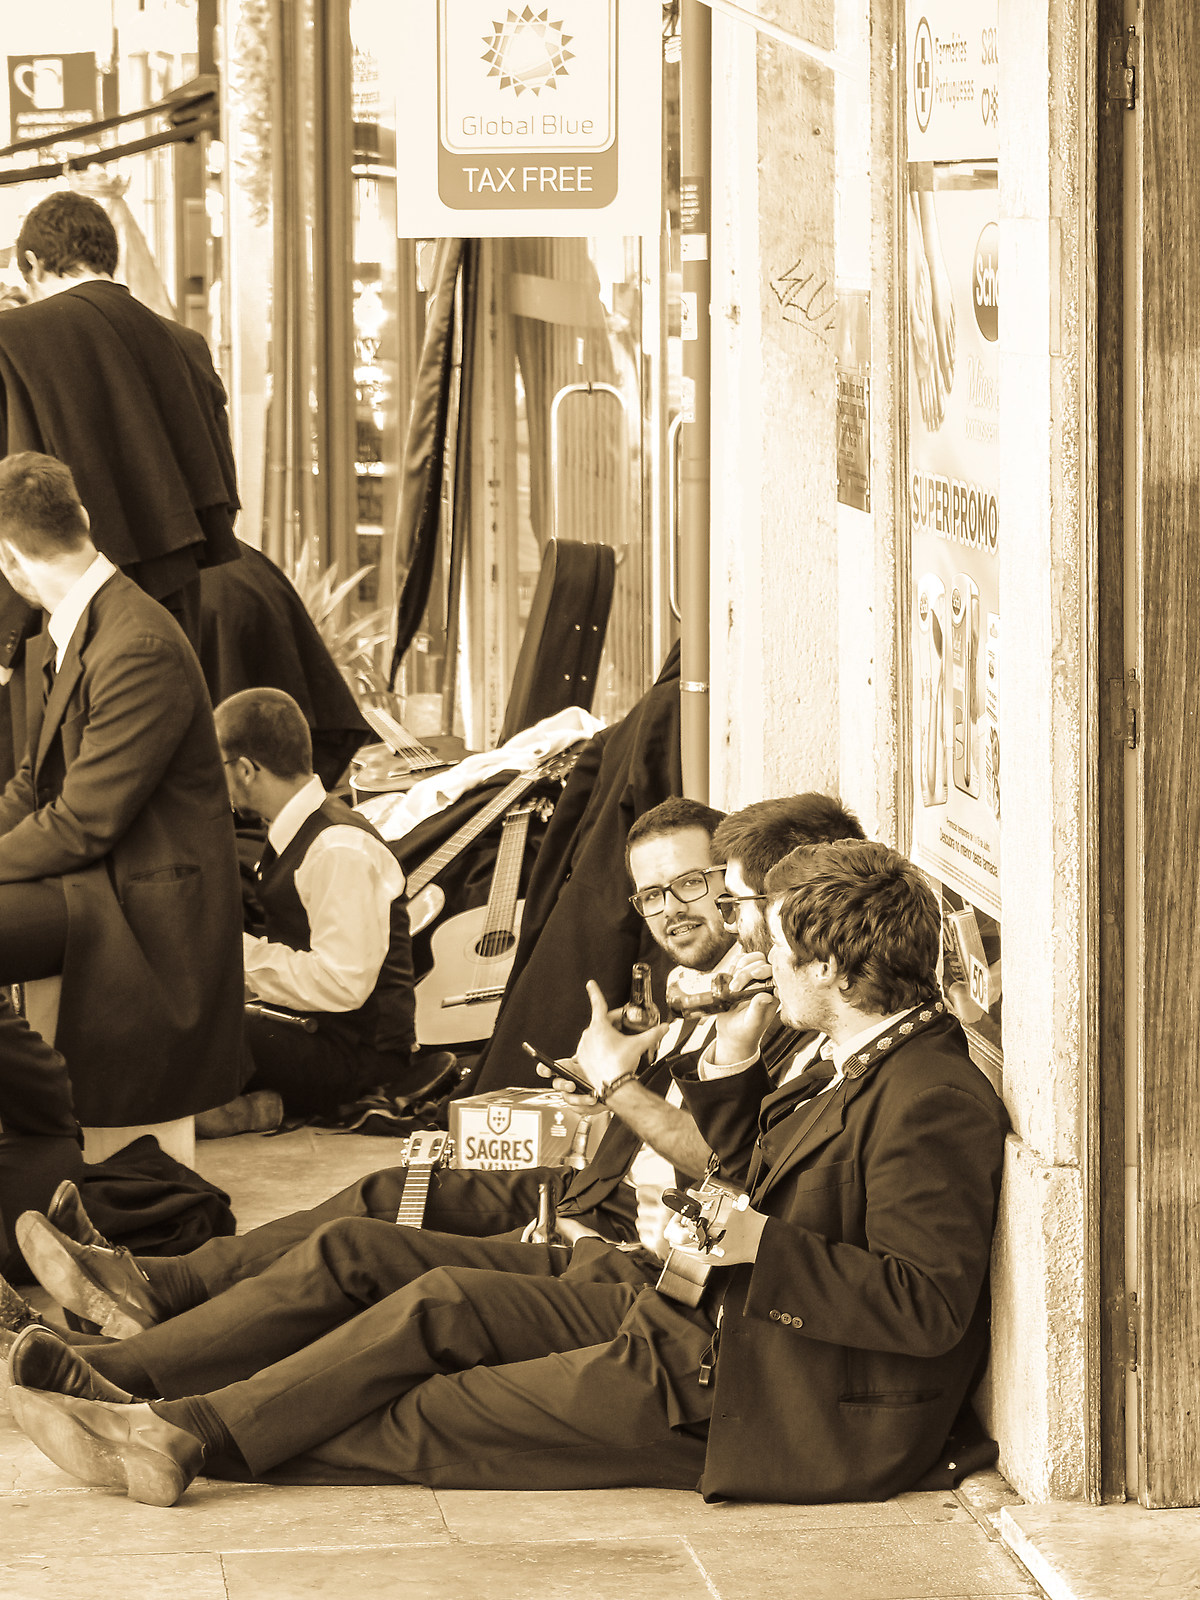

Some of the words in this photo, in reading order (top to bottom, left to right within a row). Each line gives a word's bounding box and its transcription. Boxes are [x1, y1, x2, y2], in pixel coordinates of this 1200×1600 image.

[462, 115, 534, 136] Global
[542, 114, 594, 135] Blue
[461, 167, 516, 193] TAX
[522, 166, 594, 192] FREE
[912, 474, 950, 534] SUPER
[953, 485, 998, 549] PROMO
[465, 1136, 535, 1163] SAGRES
